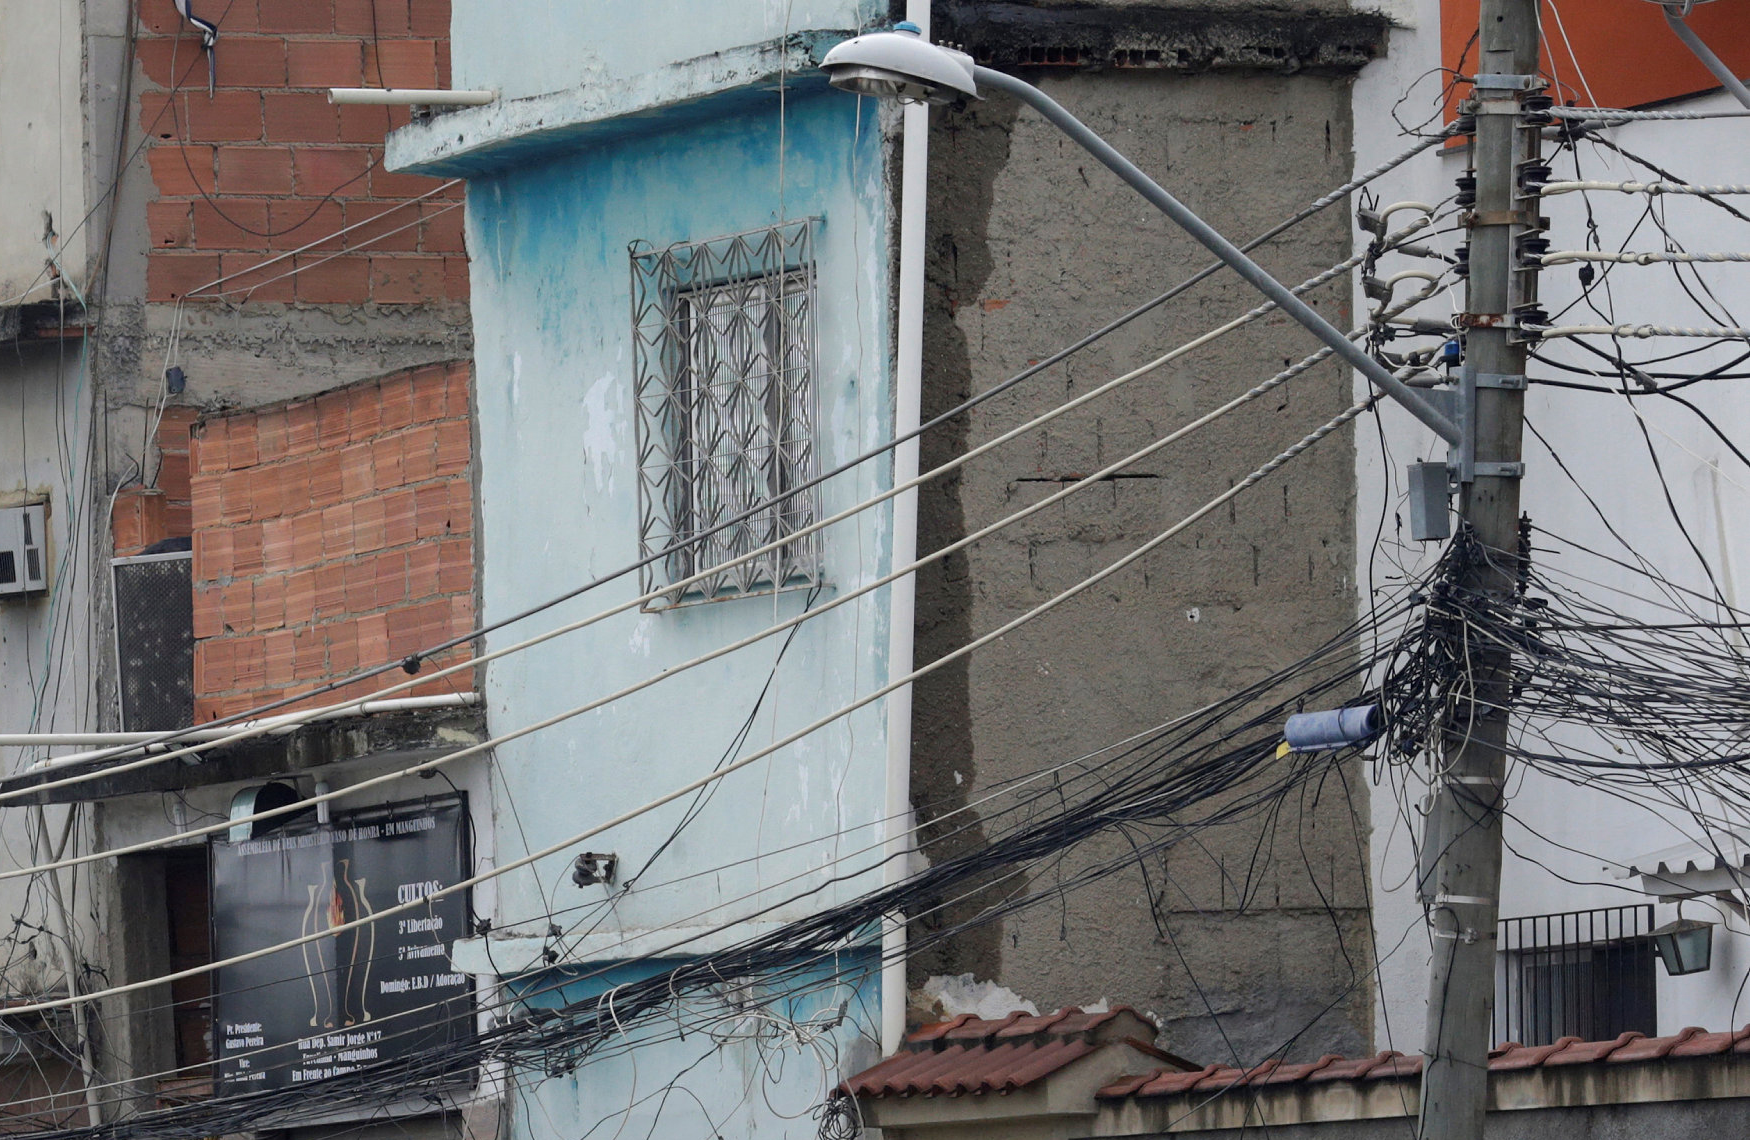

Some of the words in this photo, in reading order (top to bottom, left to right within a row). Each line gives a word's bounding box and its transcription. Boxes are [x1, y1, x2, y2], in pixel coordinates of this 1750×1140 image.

[348, 828, 357, 842] DE
[358, 825, 380, 841] HONRA
[385, 822, 395, 837] EM
[379, 979, 411, 995] Domingo:
[435, 972, 466, 988] Adoração
[245, 1036, 264, 1048] Pereira
[327, 1033, 346, 1047] Samir
[346, 1032, 366, 1047] Jorge
[292, 1069, 302, 1082] Em
[302, 1068, 323, 1081] Frente
[323, 1068, 332, 1079] ao
